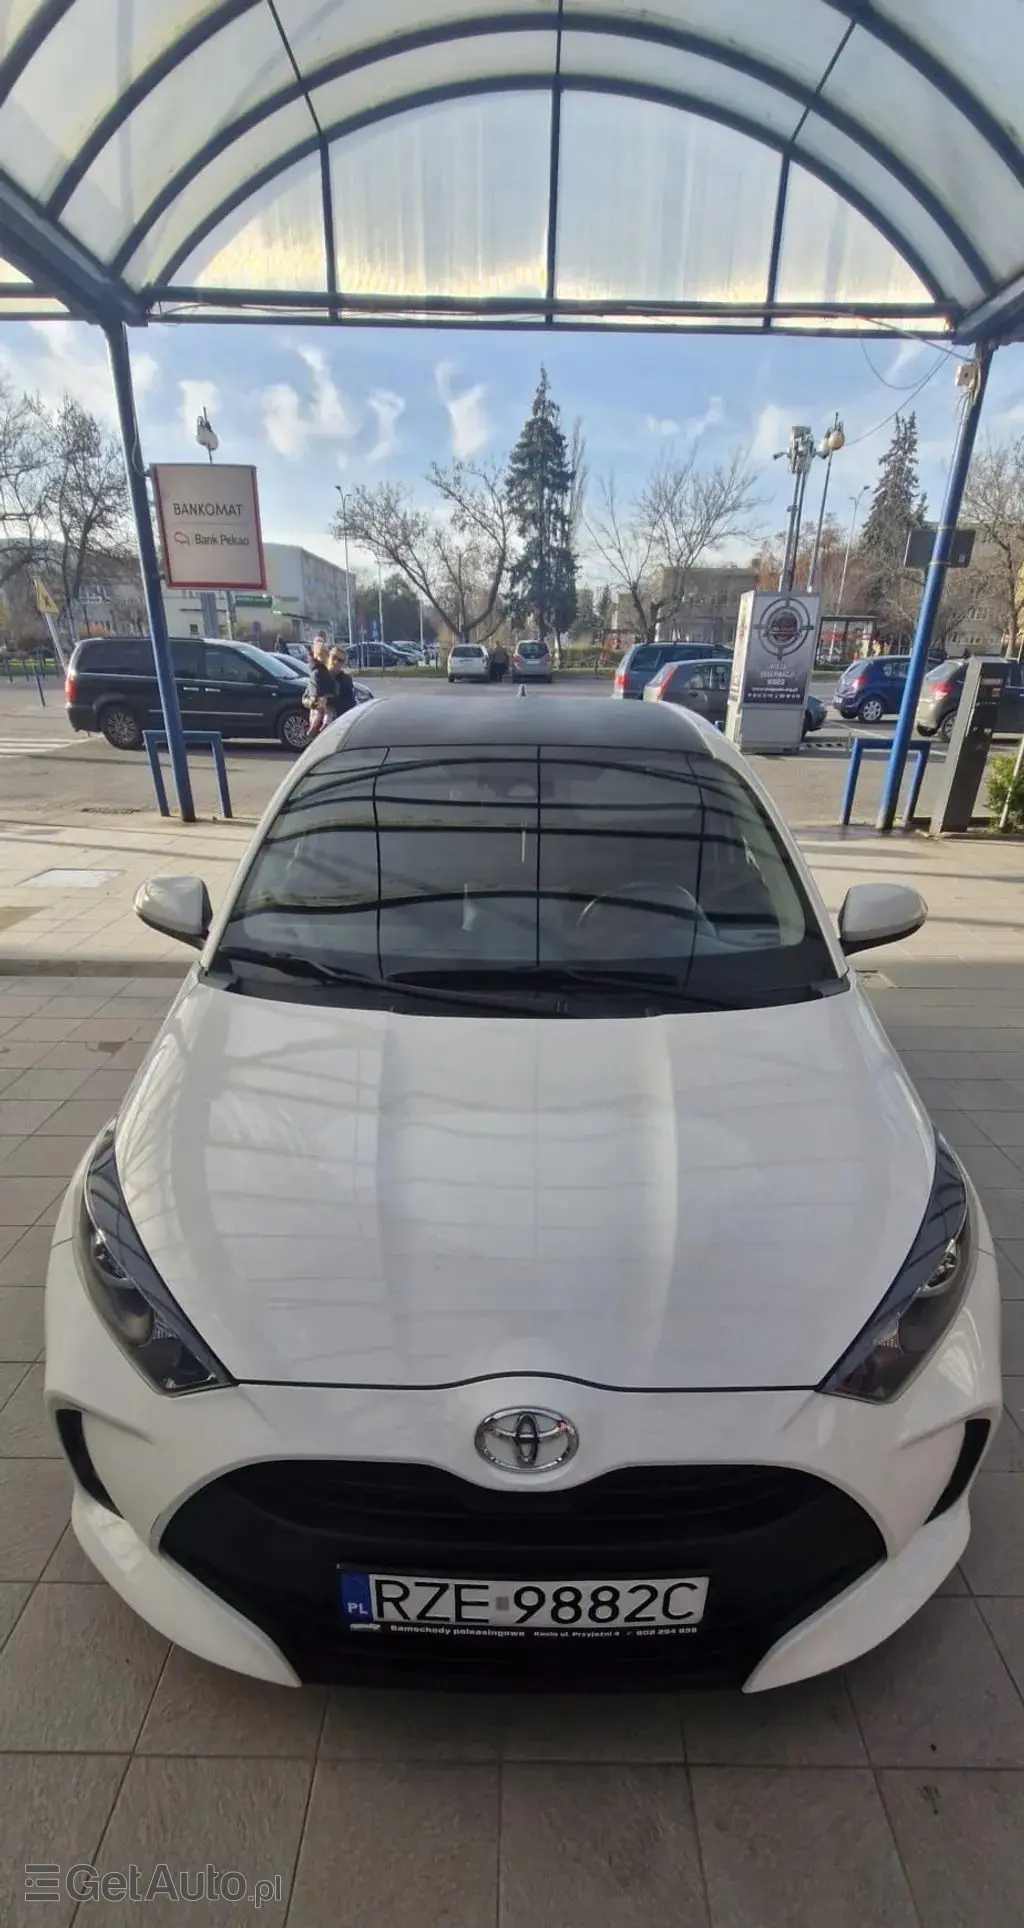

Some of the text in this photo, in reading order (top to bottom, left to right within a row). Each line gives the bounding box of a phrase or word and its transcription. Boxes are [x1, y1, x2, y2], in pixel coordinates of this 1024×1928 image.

[173, 502, 244, 517] BANKOMAT
[194, 533, 250, 546] Bank Pekao
[347, 1602, 369, 1615] PL
[375, 1579, 699, 1625] RZE 9882C
[390, 1624, 451, 1635] Samochody
